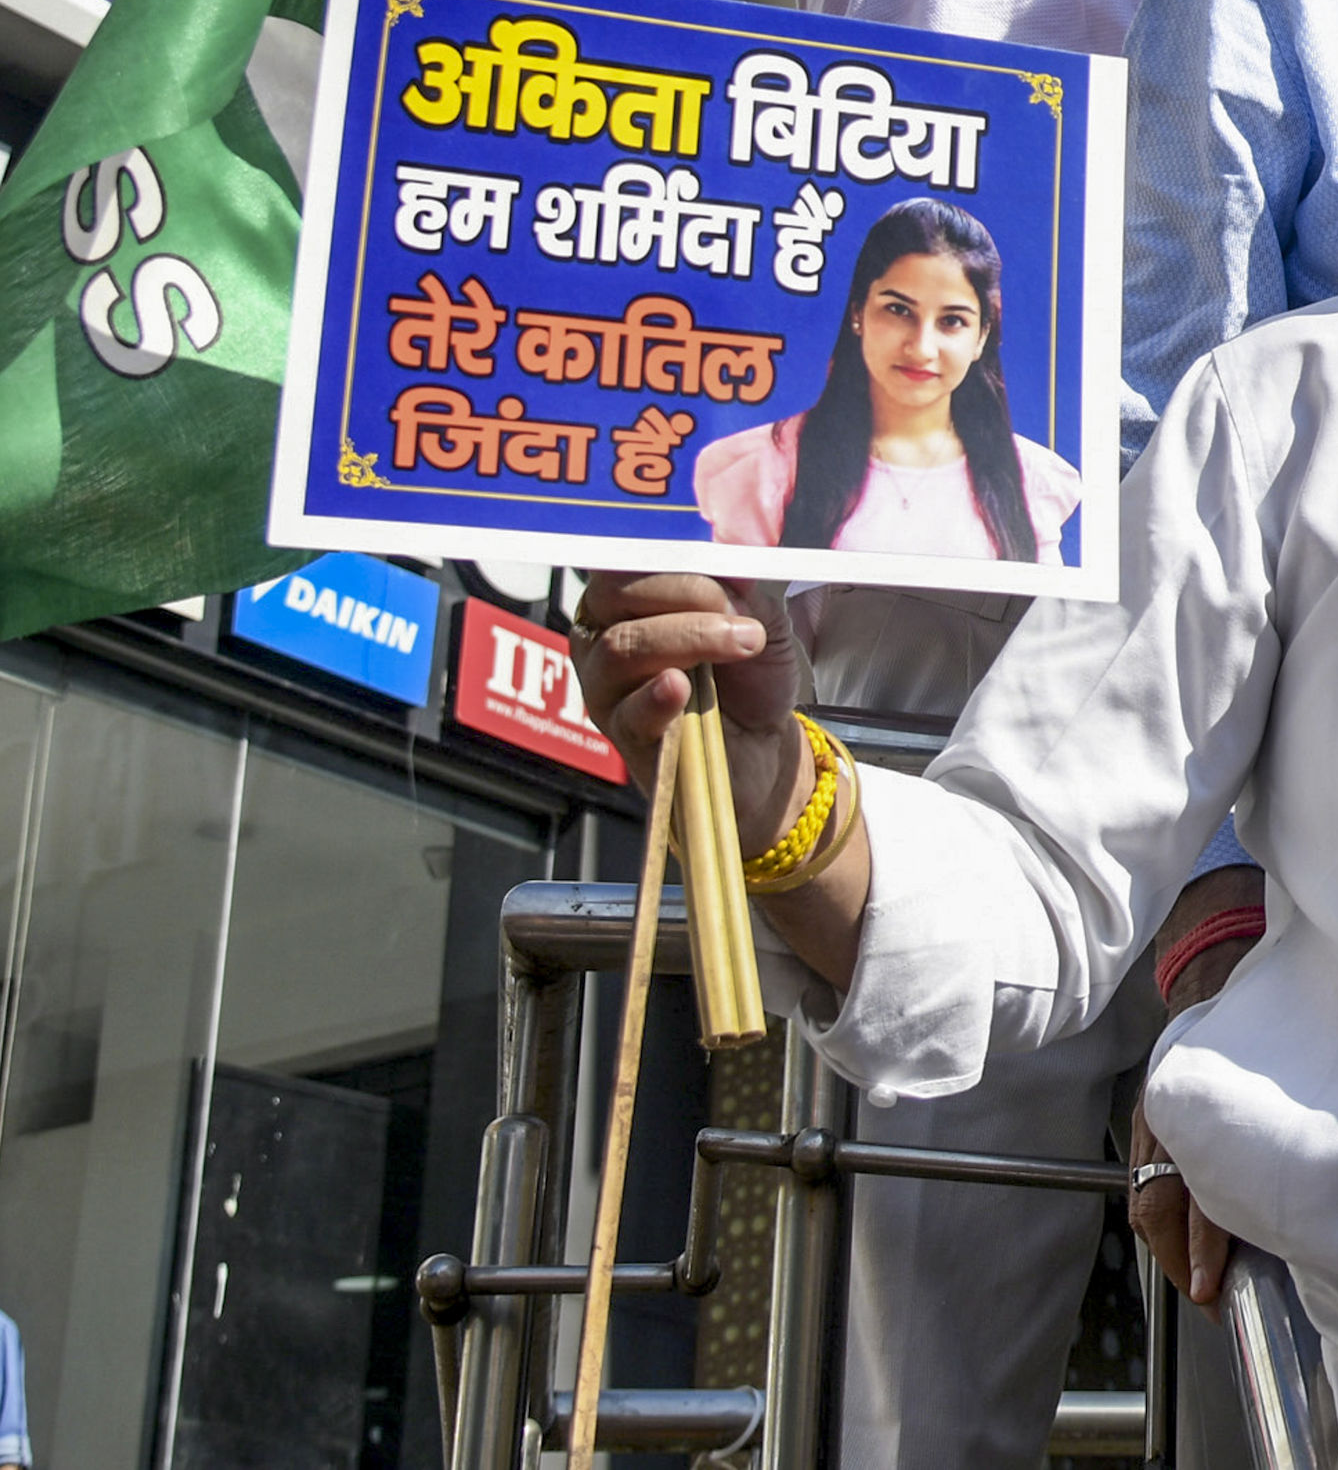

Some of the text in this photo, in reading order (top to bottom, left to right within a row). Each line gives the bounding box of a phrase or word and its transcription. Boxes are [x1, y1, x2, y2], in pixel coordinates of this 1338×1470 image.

[728, 54, 987, 189] बिटिया
[395, 165, 520, 251] हम
[772, 181, 845, 293] हैं
[388, 272, 783, 404] तेरे कातिल
[390, 386, 694, 496] जिंदा हैं
[284, 575, 419, 655] DAIKIN
